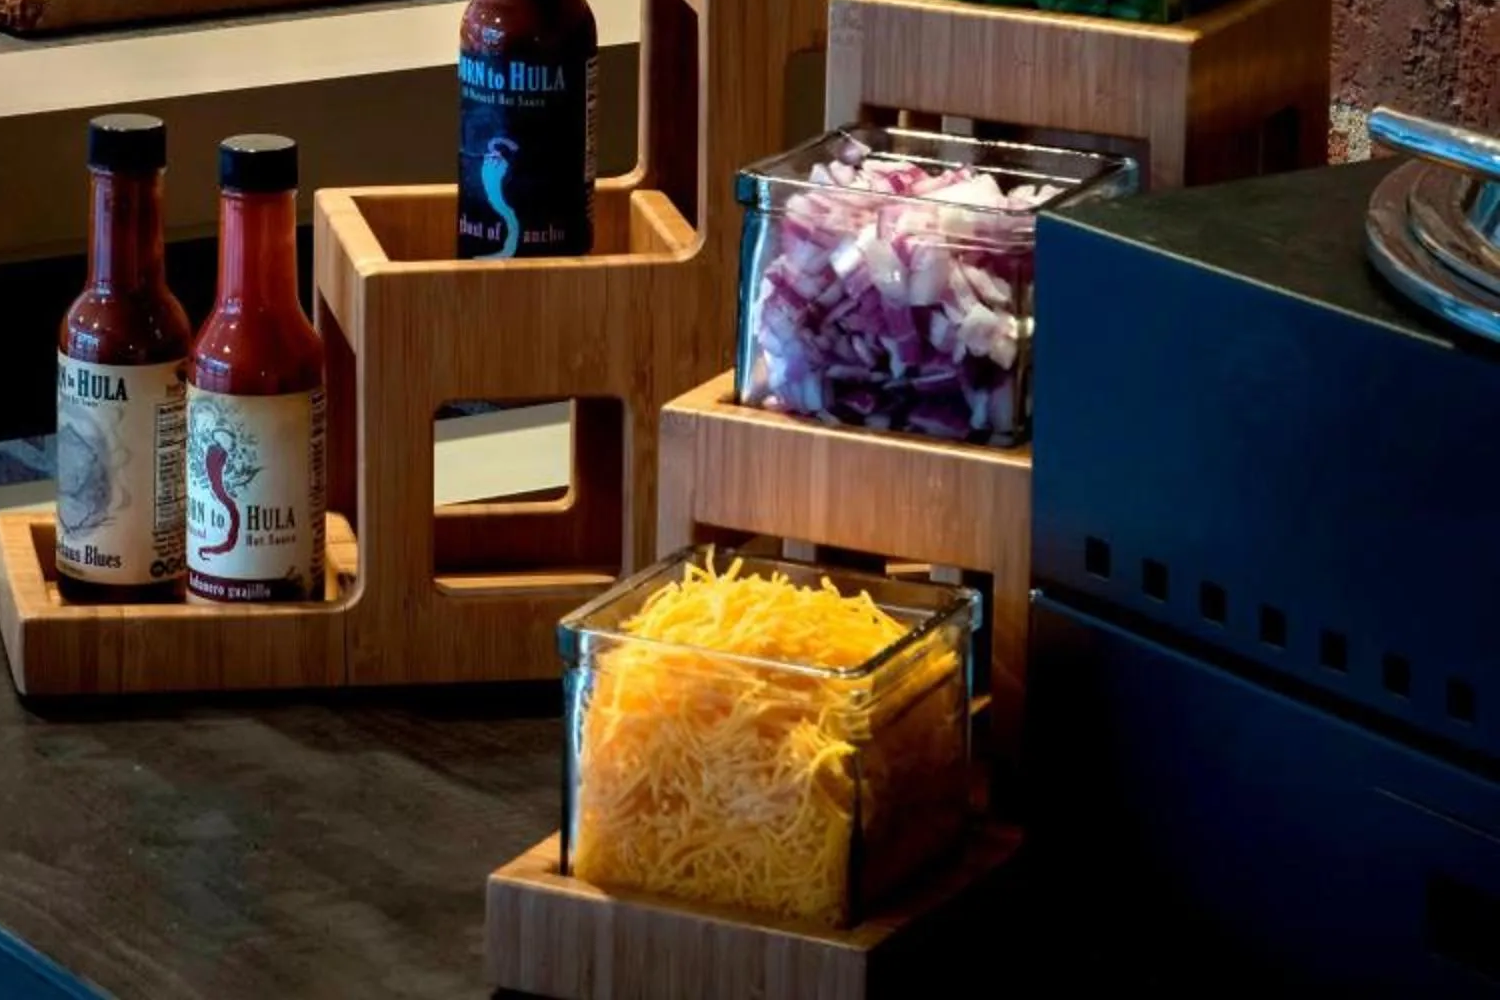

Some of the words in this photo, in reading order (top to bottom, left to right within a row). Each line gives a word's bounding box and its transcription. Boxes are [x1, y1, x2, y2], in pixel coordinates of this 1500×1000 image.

[487, 66, 505, 90] to
[508, 59, 567, 92] HULA
[77, 367, 128, 401] HULA
[211, 508, 226, 529] to
[246, 504, 296, 531] HULA
[83, 544, 122, 569] Blues
